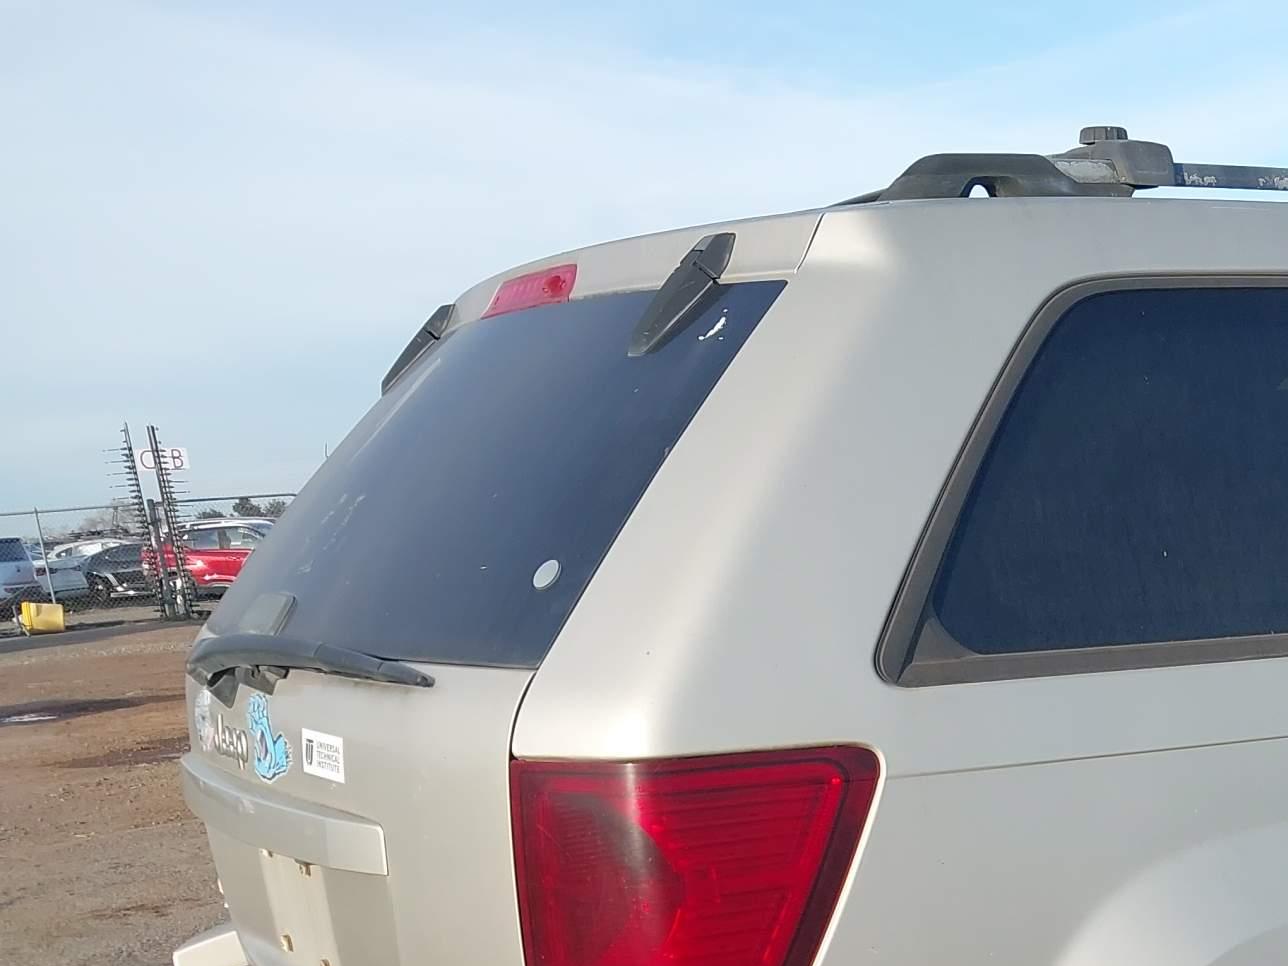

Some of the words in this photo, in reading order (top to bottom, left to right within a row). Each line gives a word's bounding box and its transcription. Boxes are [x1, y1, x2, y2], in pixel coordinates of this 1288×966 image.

[316, 740, 340, 755] UNIVERSAL
[316, 750, 340, 765] TECHNICAL
[316, 759, 340, 774] INSTITUTE
